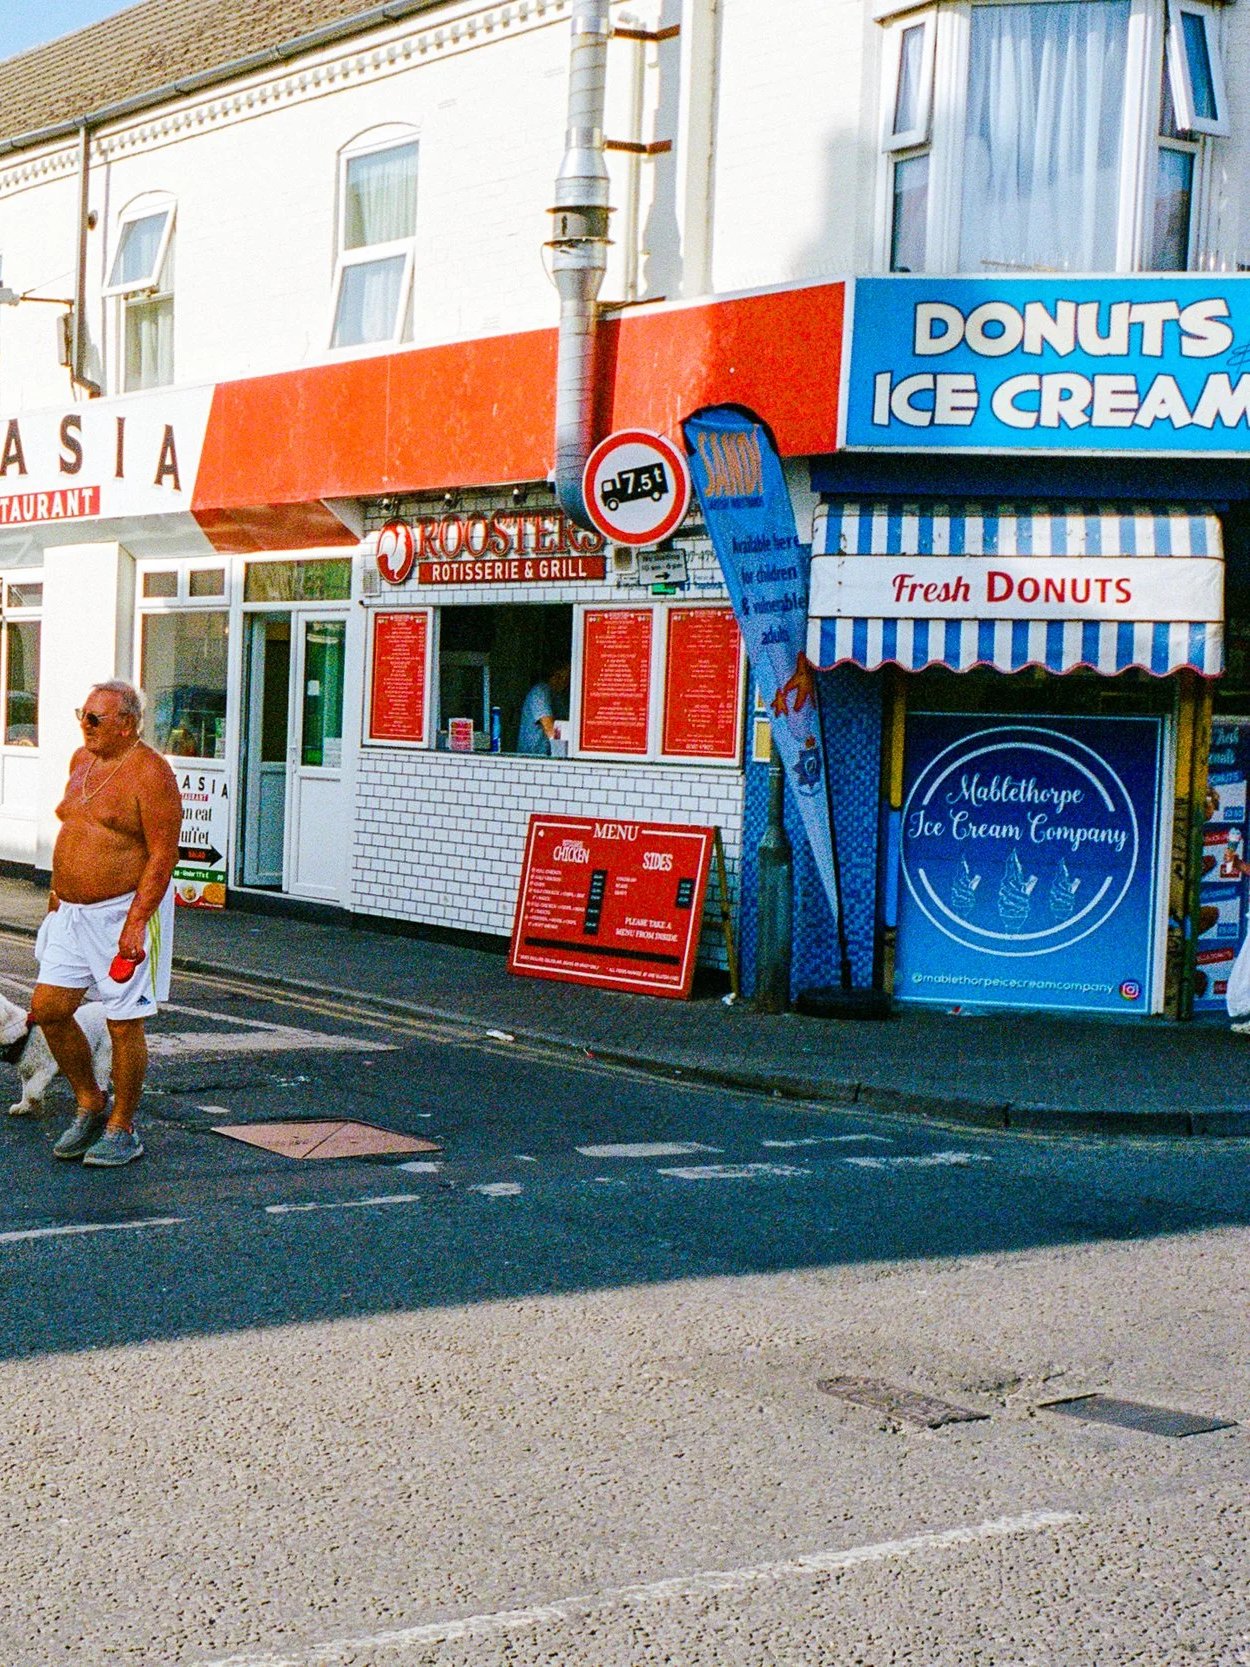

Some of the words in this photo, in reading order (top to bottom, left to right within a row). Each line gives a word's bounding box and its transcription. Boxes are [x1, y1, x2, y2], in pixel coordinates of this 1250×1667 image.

[912, 297, 1235, 358] DONUTS
[872, 371, 980, 429] ICE
[772, 532, 800, 551] here
[432, 562, 519, 582] ROTISSERIE
[524, 562, 534, 577] &
[539, 559, 587, 577] GRILL
[756, 564, 797, 583] children
[891, 573, 971, 602] Fresh
[946, 772, 1084, 814] Mablethorpe
[593, 823, 639, 842] MENU
[908, 809, 946, 839] Ice
[950, 810, 1024, 840] Cream
[1027, 811, 1128, 852] Company
[553, 846, 590, 864] CHICKEN
[642, 851, 673, 872] SIDES
